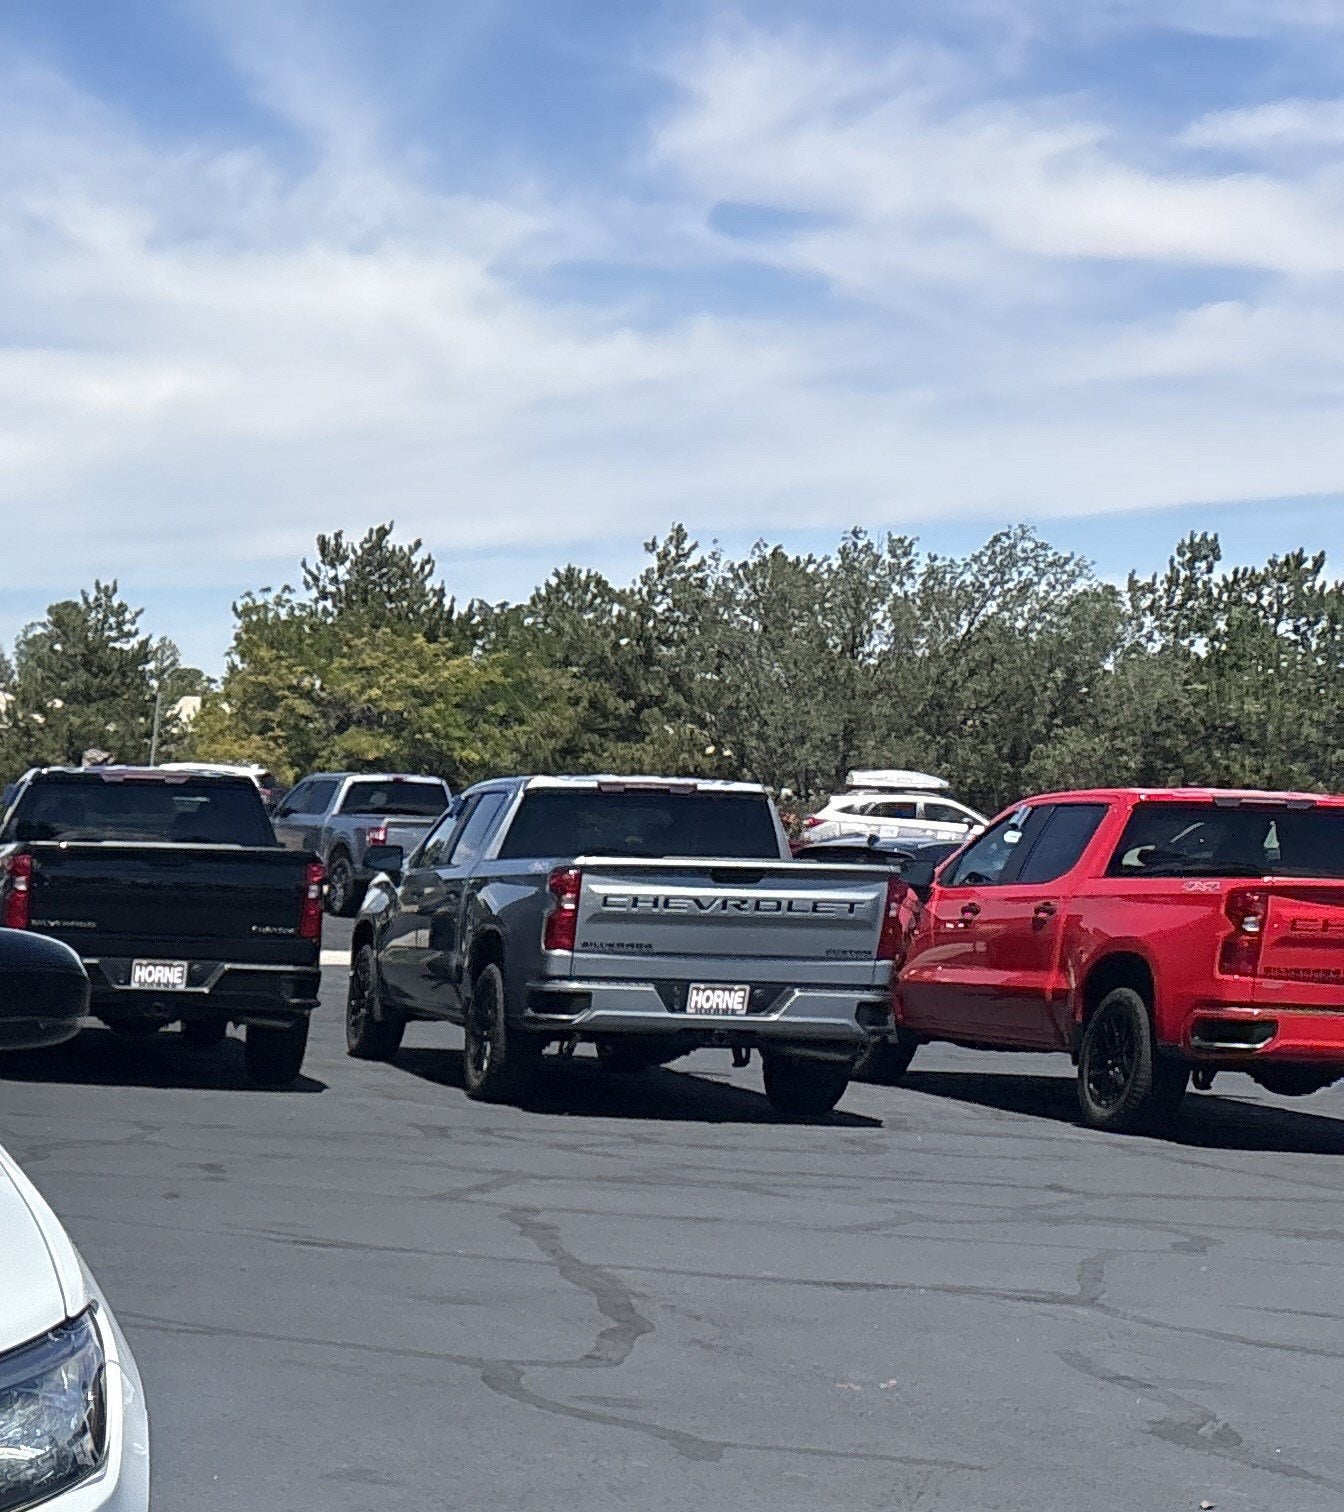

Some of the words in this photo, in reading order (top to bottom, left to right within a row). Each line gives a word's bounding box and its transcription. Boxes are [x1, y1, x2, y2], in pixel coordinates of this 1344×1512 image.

[601, 895, 868, 917] CHEVROLET
[134, 965, 184, 984] HORNE
[690, 989, 745, 1010] HORNE
